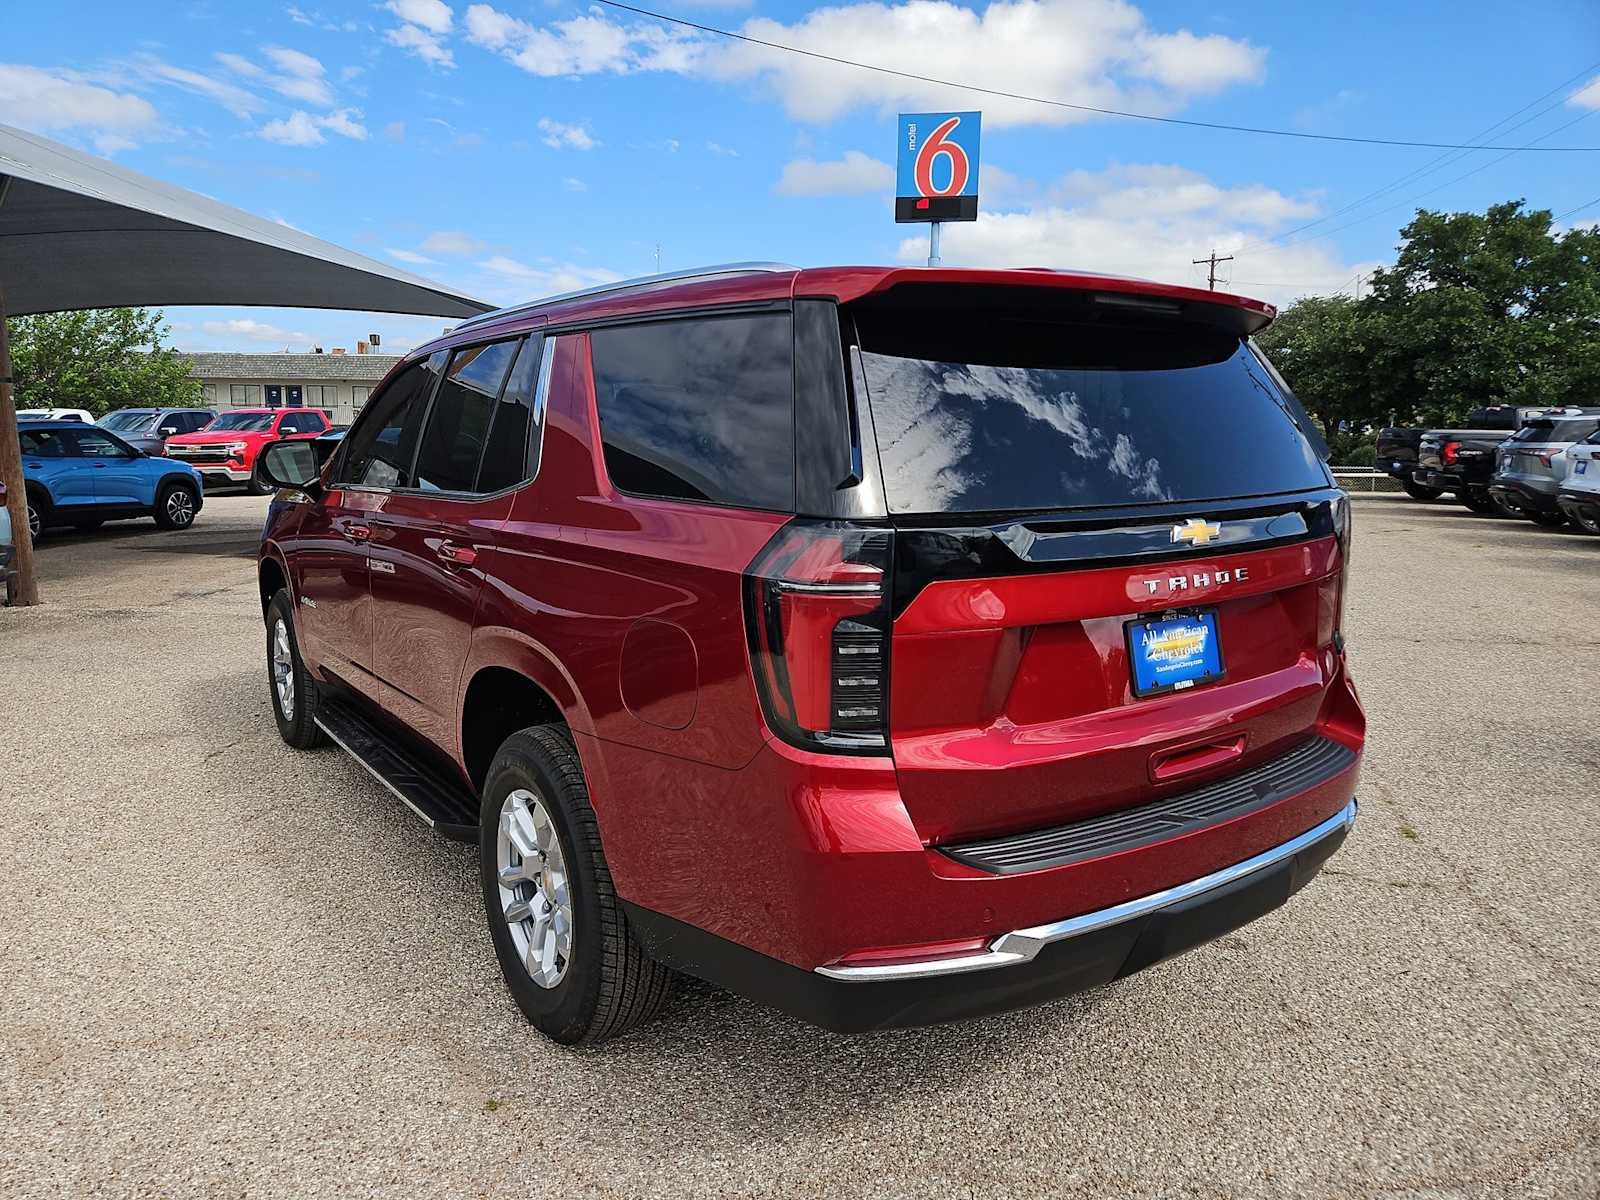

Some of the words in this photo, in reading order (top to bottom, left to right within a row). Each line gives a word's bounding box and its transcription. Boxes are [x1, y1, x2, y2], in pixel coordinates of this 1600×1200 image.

[908, 123, 917, 151] motel
[914, 116, 970, 197] 6
[1143, 567, 1249, 594] TAHOE
[1142, 630, 1157, 646] All
[1161, 625, 1209, 642] American
[1153, 643, 1204, 662] Chevrolet
